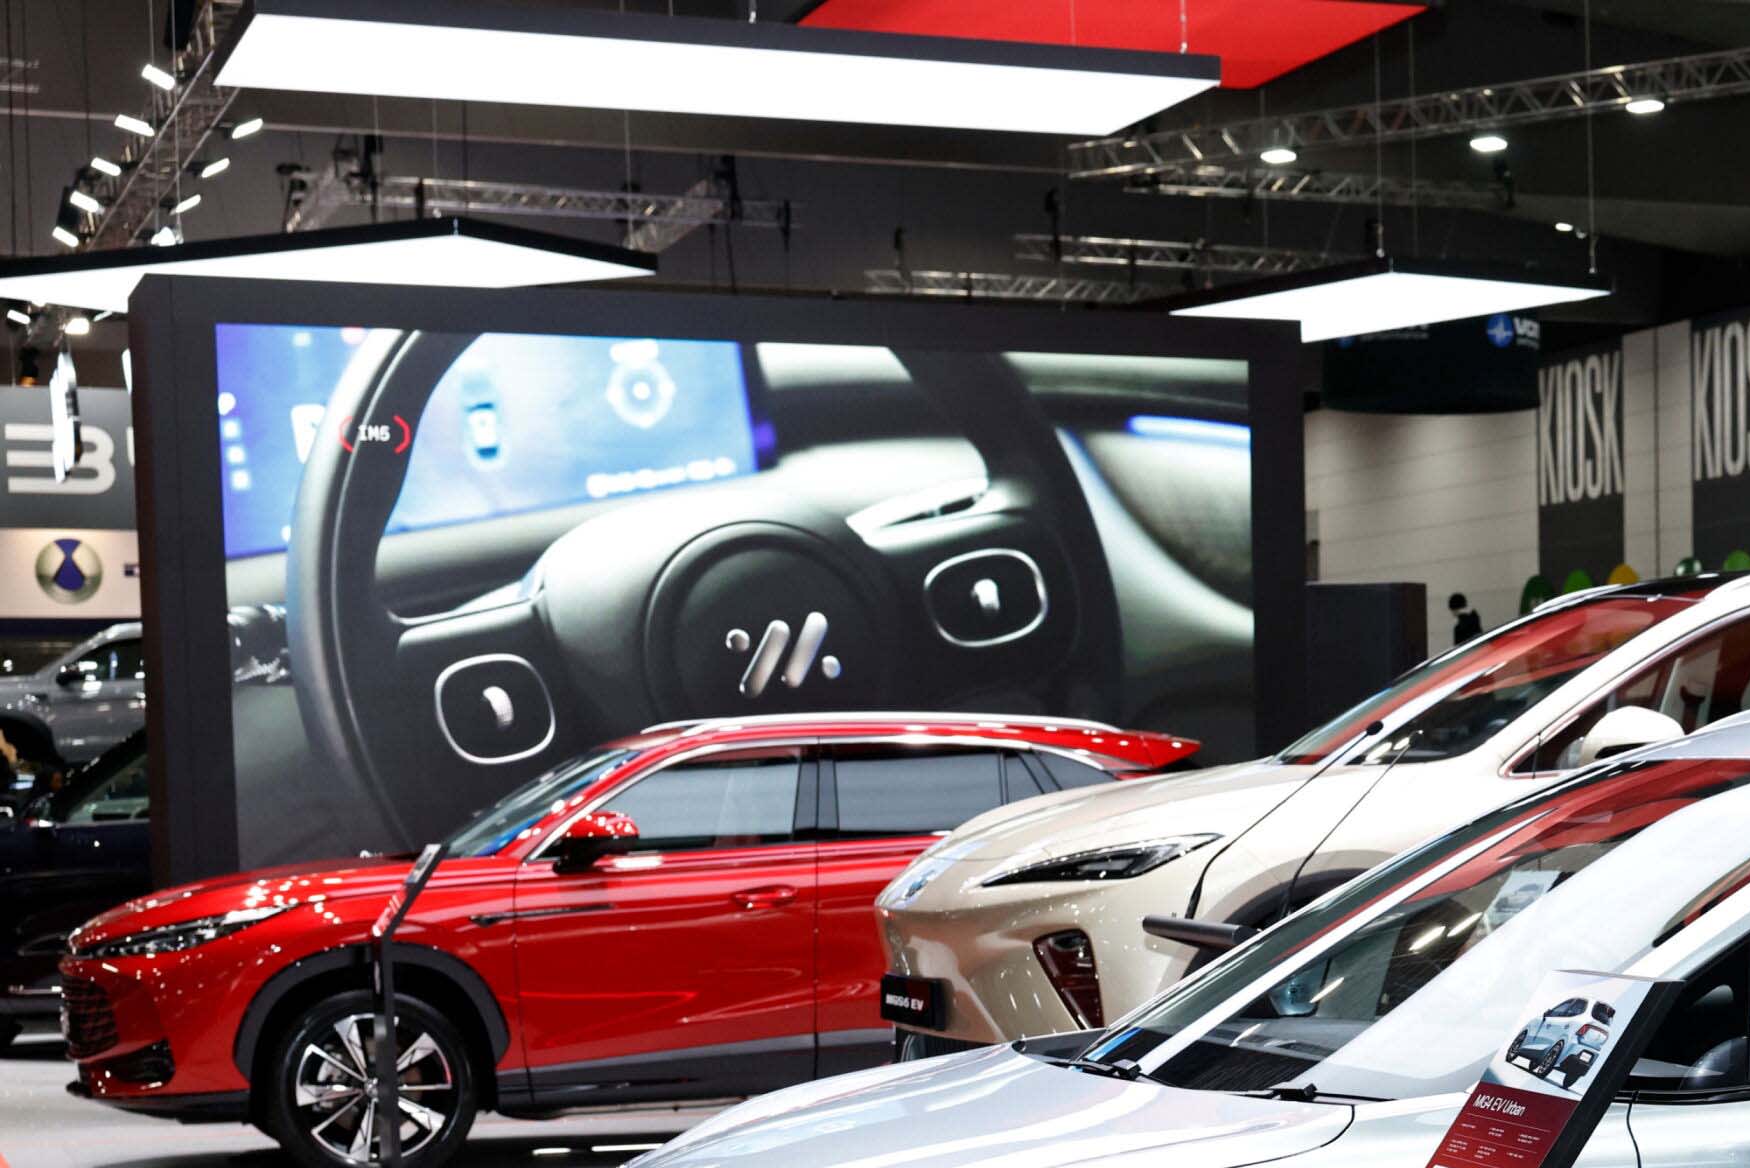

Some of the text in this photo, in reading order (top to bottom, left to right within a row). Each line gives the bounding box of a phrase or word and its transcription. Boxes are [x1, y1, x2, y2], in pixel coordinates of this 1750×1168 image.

[358, 424, 391, 442] IM5
[1539, 351, 1623, 507] KIOSK
[911, 999, 924, 1011] EV
[1473, 1094, 1526, 1116] MG4 EV Urban
